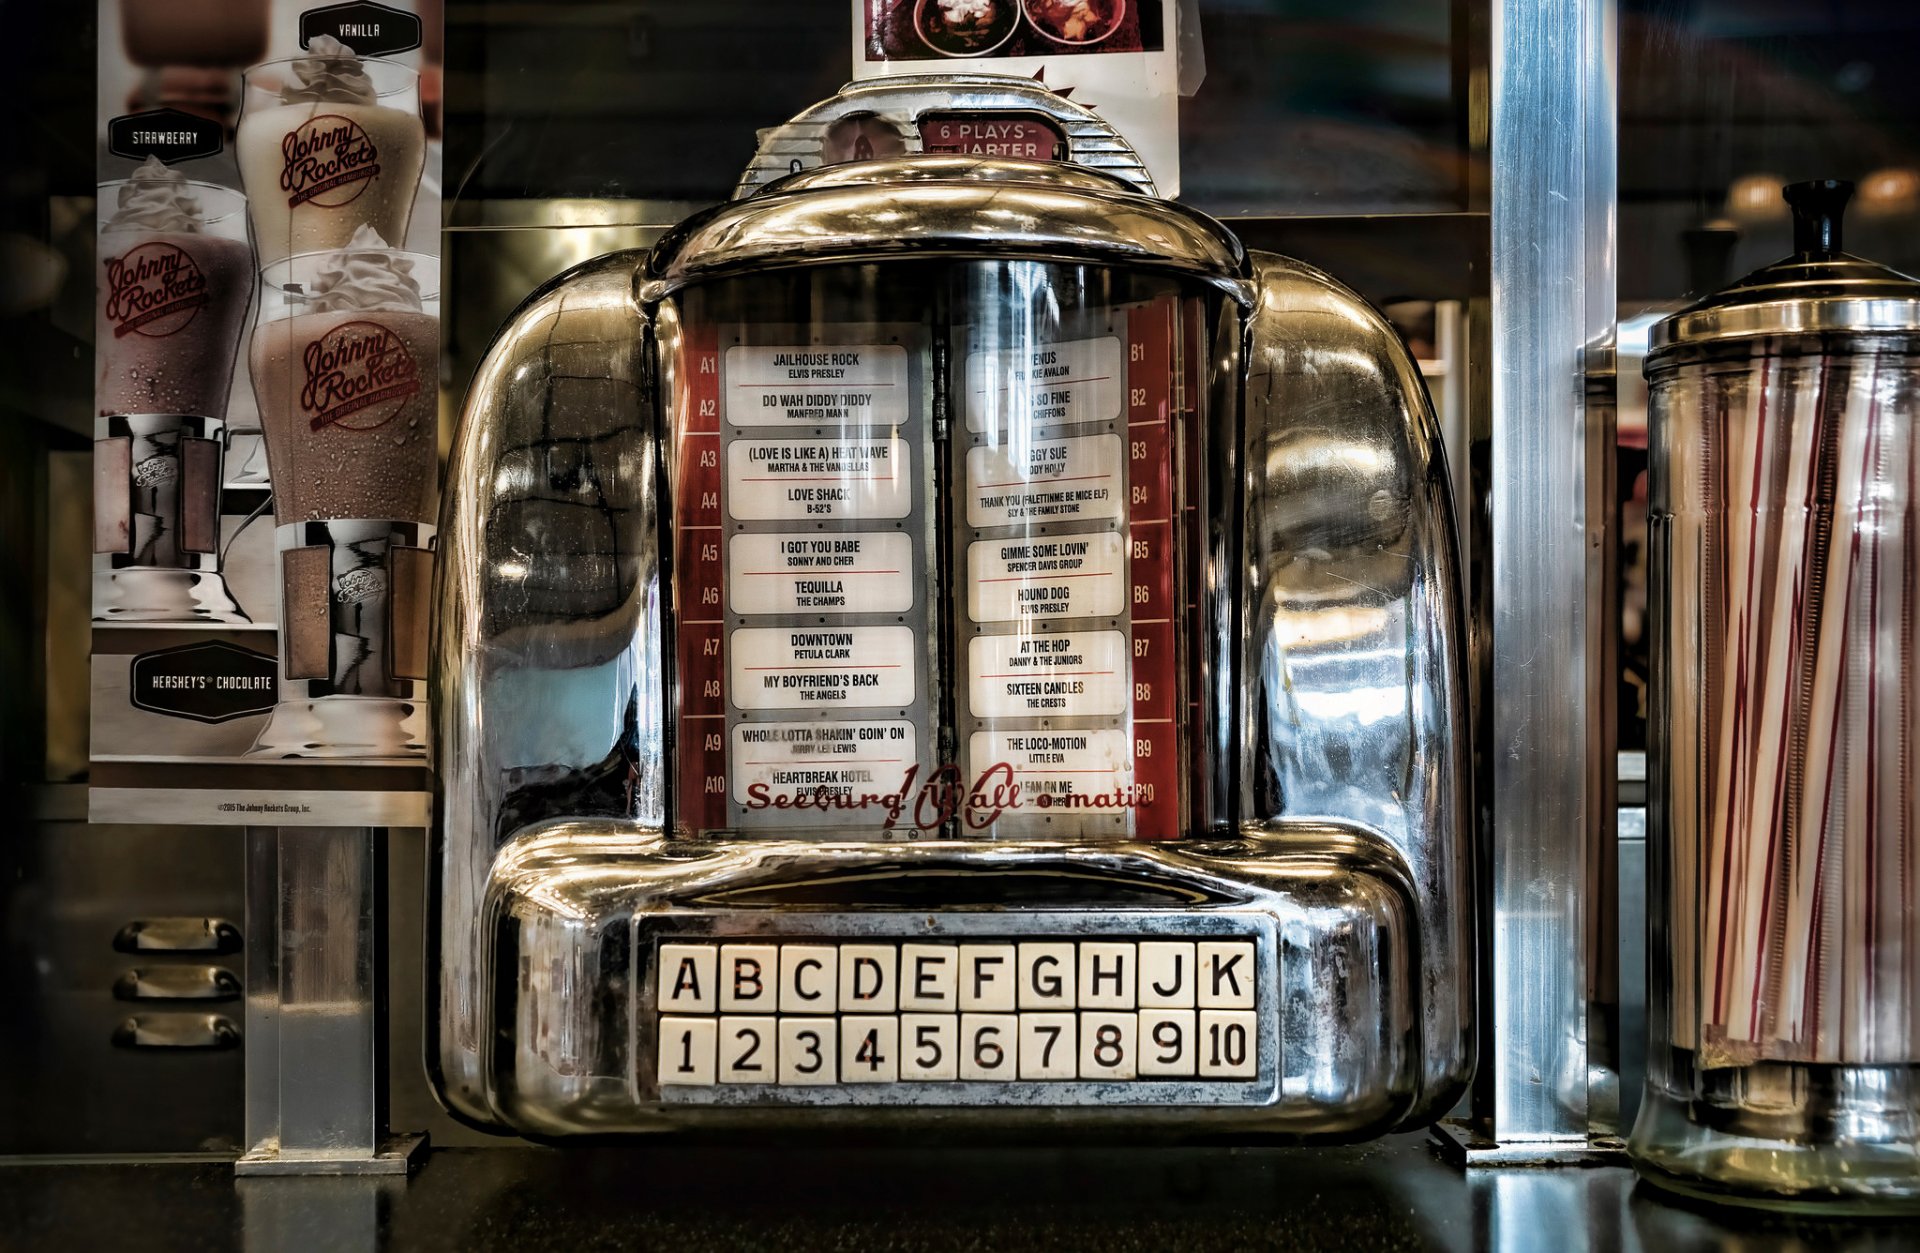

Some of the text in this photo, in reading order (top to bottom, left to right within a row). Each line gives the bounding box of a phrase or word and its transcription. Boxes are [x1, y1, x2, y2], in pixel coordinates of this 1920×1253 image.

[339, 24, 379, 36] VANILLA
[133, 132, 197, 144] STRAWBERRY
[941, 125, 950, 138] 6
[280, 123, 363, 192] Johnny
[106, 250, 191, 320] Johnny
[1131, 344, 1144, 361] B1
[700, 357, 715, 373] A1
[773, 354, 859, 366] JAILHOUSE ROCK
[301, 330, 399, 411] Johnny
[788, 369, 845, 378] ELVIS PRESLEY
[1044, 366, 1070, 377] AVALON
[763, 395, 776, 407] DO
[780, 395, 803, 406] WAH
[806, 395, 838, 406] DIDDY
[1051, 391, 1070, 404] FINE
[1131, 389, 1146, 407] B2
[700, 400, 715, 416] A2
[749, 447, 779, 462] (LOVE
[782, 448, 791, 459] IS
[794, 448, 816, 459] LIKE
[818, 447, 829, 460] A)
[1050, 447, 1067, 460] SUE
[1132, 442, 1147, 460] B3
[700, 451, 716, 467] A3
[768, 463, 825, 472] MARTHA & THE
[701, 492, 717, 509] A4
[788, 489, 814, 500] LOVE
[980, 498, 1004, 508] THANK
[1006, 497, 1020, 506] YOU
[1066, 492, 1074, 500] BE
[1094, 489, 1108, 500] ELF)
[1132, 486, 1147, 504] B4
[807, 504, 832, 513] B-52'S
[1020, 508, 1024, 516] &
[1038, 505, 1059, 515] FAMILY
[1060, 504, 1079, 513] STONE
[702, 544, 718, 561] A5
[782, 541, 860, 553] I GOT YOU BABE
[1001, 542, 1089, 560] GIMME SOME LOVIN'
[1134, 541, 1148, 559] B5
[787, 556, 854, 566] SONNY AND CHER
[1007, 559, 1083, 572] SPENCER DAVIS GROUP
[795, 581, 843, 594] TEQUILLA
[1018, 587, 1069, 601] HOUND DOG
[1134, 586, 1149, 603] B6
[702, 588, 718, 604] A6
[796, 597, 845, 606] THE CHAMPS
[1040, 602, 1069, 613] PRESLEY
[704, 639, 719, 655] A7
[791, 634, 853, 646] DOWNTOWN
[1021, 639, 1070, 653] AT THE HOP
[794, 649, 850, 659] PETULA CLARK
[1134, 639, 1149, 657] B7
[1009, 655, 1082, 667] DANNY & THE JUNIORS
[217, 676, 271, 689] CHOCOLATE
[764, 674, 879, 688] MY BOYFRIEND'S BACK
[704, 681, 720, 697] A8
[800, 691, 815, 700] THE
[1007, 682, 1084, 696] SIXTEEN CANDLES
[1136, 683, 1150, 701] B8
[1027, 698, 1066, 708] THE CRESTS
[859, 728, 887, 740] GOIN'
[890, 728, 904, 739] ON
[705, 735, 721, 751] A9
[832, 744, 856, 753] LEWIS
[1007, 737, 1086, 750] THE LOCO-MOTION
[1136, 739, 1151, 757] B9
[1029, 753, 1064, 763] LITTLE EVA
[705, 776, 725, 793] A10
[773, 772, 838, 784] HEARTBREAK
[1059, 782, 1072, 792] ME
[747, 783, 903, 821] Seeburg
[672, 954, 1244, 1000] A B C D E F G H J K
[678, 1021, 1246, 1073] 1 2 3 4 5 6 7 8 9 10
